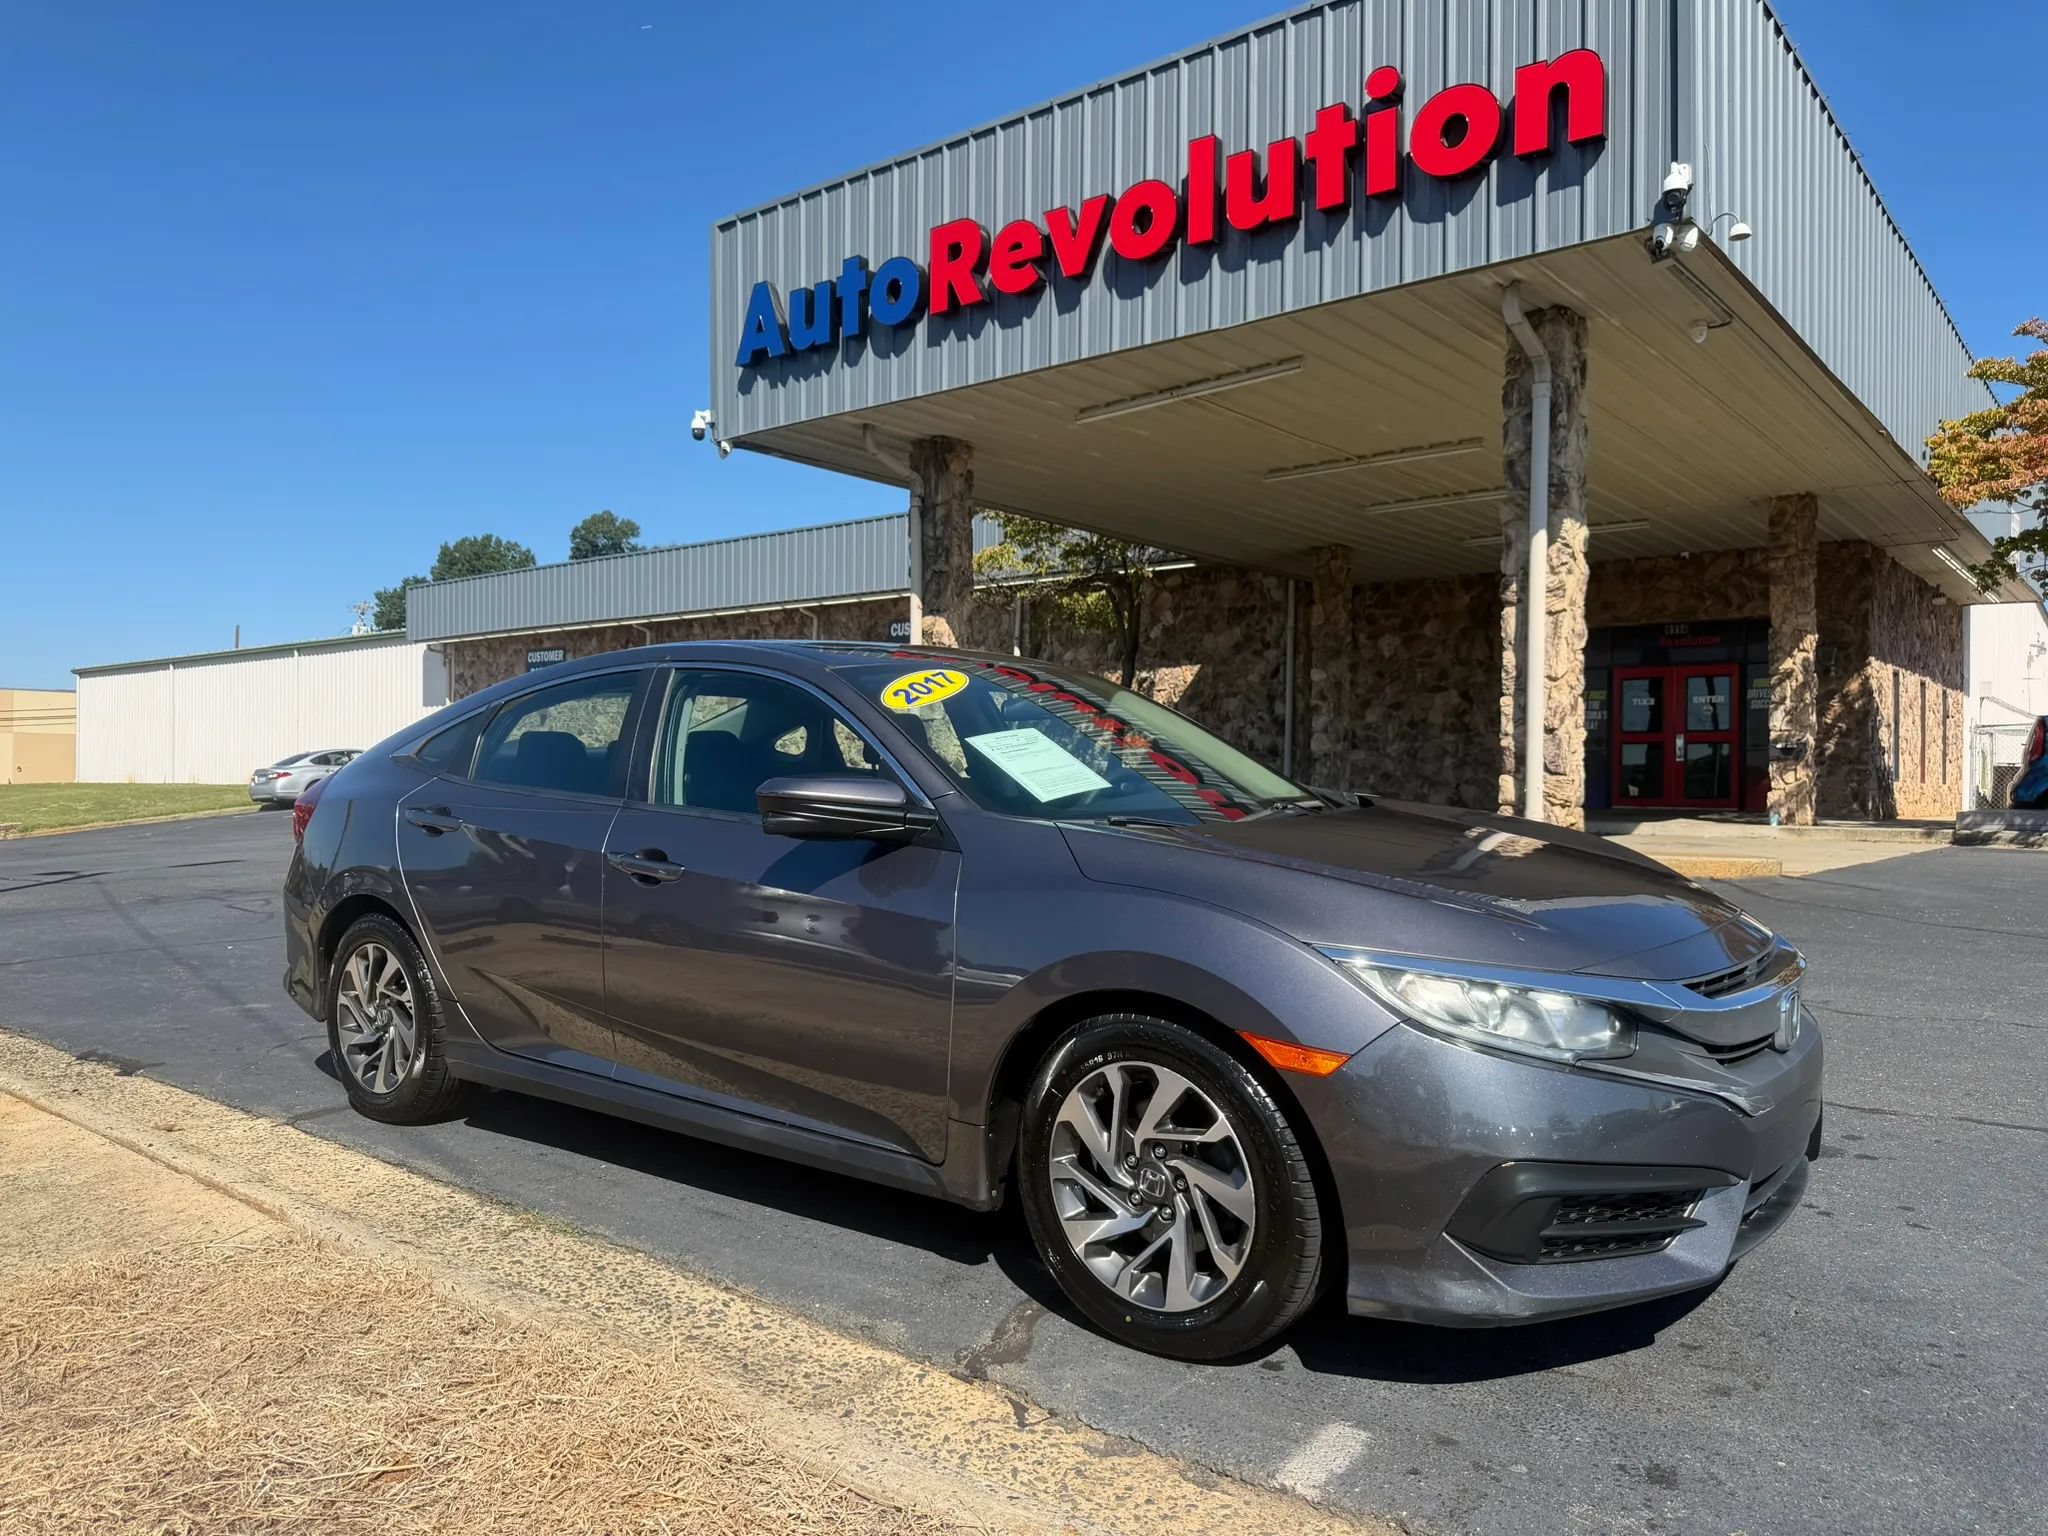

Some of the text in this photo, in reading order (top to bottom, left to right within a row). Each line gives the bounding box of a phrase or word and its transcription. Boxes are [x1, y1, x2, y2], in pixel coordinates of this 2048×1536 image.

[527, 650, 564, 663] CUSTOMER
[893, 671, 955, 705] 2017
[1692, 695, 1725, 704] ENTER
